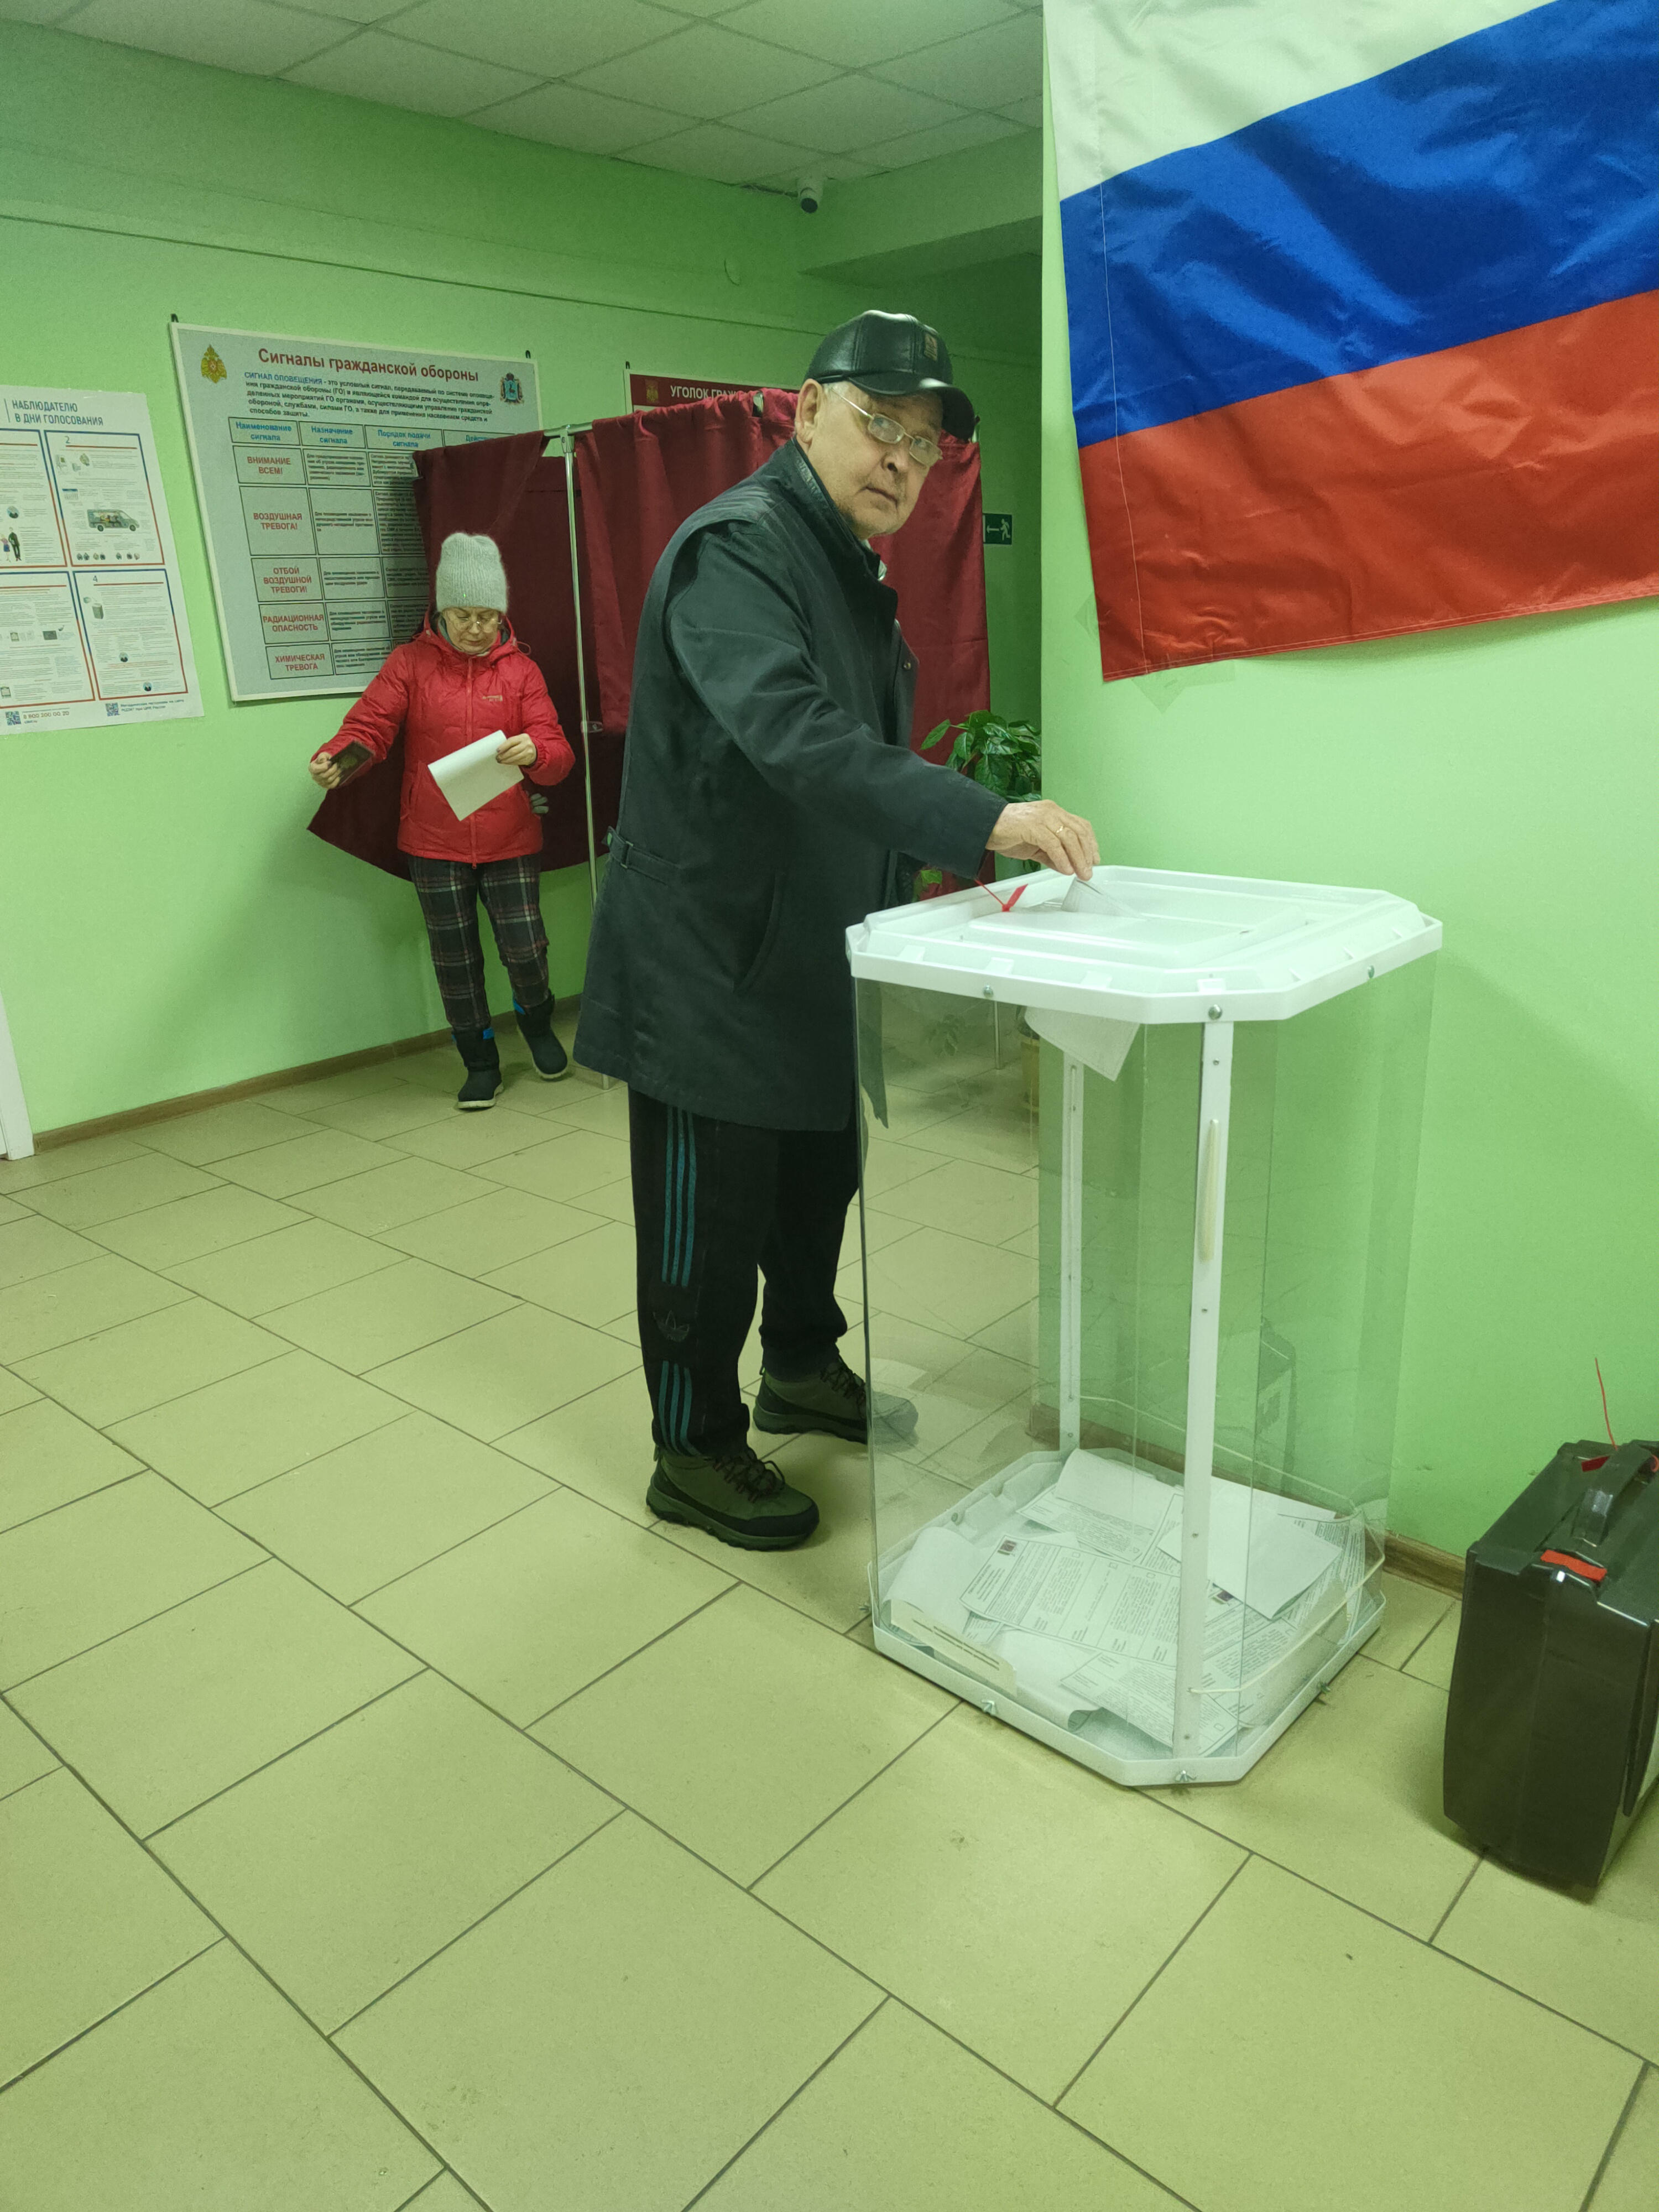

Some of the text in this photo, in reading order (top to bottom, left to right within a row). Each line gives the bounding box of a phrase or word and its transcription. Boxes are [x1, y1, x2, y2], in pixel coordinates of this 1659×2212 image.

[258, 348, 478, 382] Сигналы гражданской обороны
[244, 372, 272, 380] СИГНАЛ
[274, 374, 322, 385] ОПОВЕЩЕНИЯ
[260, 382, 301, 392] гражданской
[671, 385, 709, 399] УГОЛОК
[282, 393, 324, 402] мероприятий
[12, 400, 78, 412] НАБЛЮДАТЕЛЮ
[15, 413, 103, 426] В ДНИ ГОЛОСОВАНИЯ
[236, 421, 292, 431] Наименование
[311, 426, 353, 435] Назначение
[251, 433, 280, 441] сигнала
[378, 429, 406, 439] Порядок
[247, 456, 291, 465] ВНИМАНИЕ
[258, 466, 283, 474] ВСЕМ!
[253, 513, 302, 521] ВОЗДУШНАЯ
[273, 566, 299, 574] ОТБОЙ
[263, 575, 311, 585] ВОЗДУШНОЙ
[263, 614, 324, 623] РАДИАЦИОННАЯ
[272, 624, 318, 632] ОПАСНОСТЬ
[275, 654, 325, 663] ХИМИЧЕСКАЯ
[285, 663, 319, 671] ТРЕВОГА
